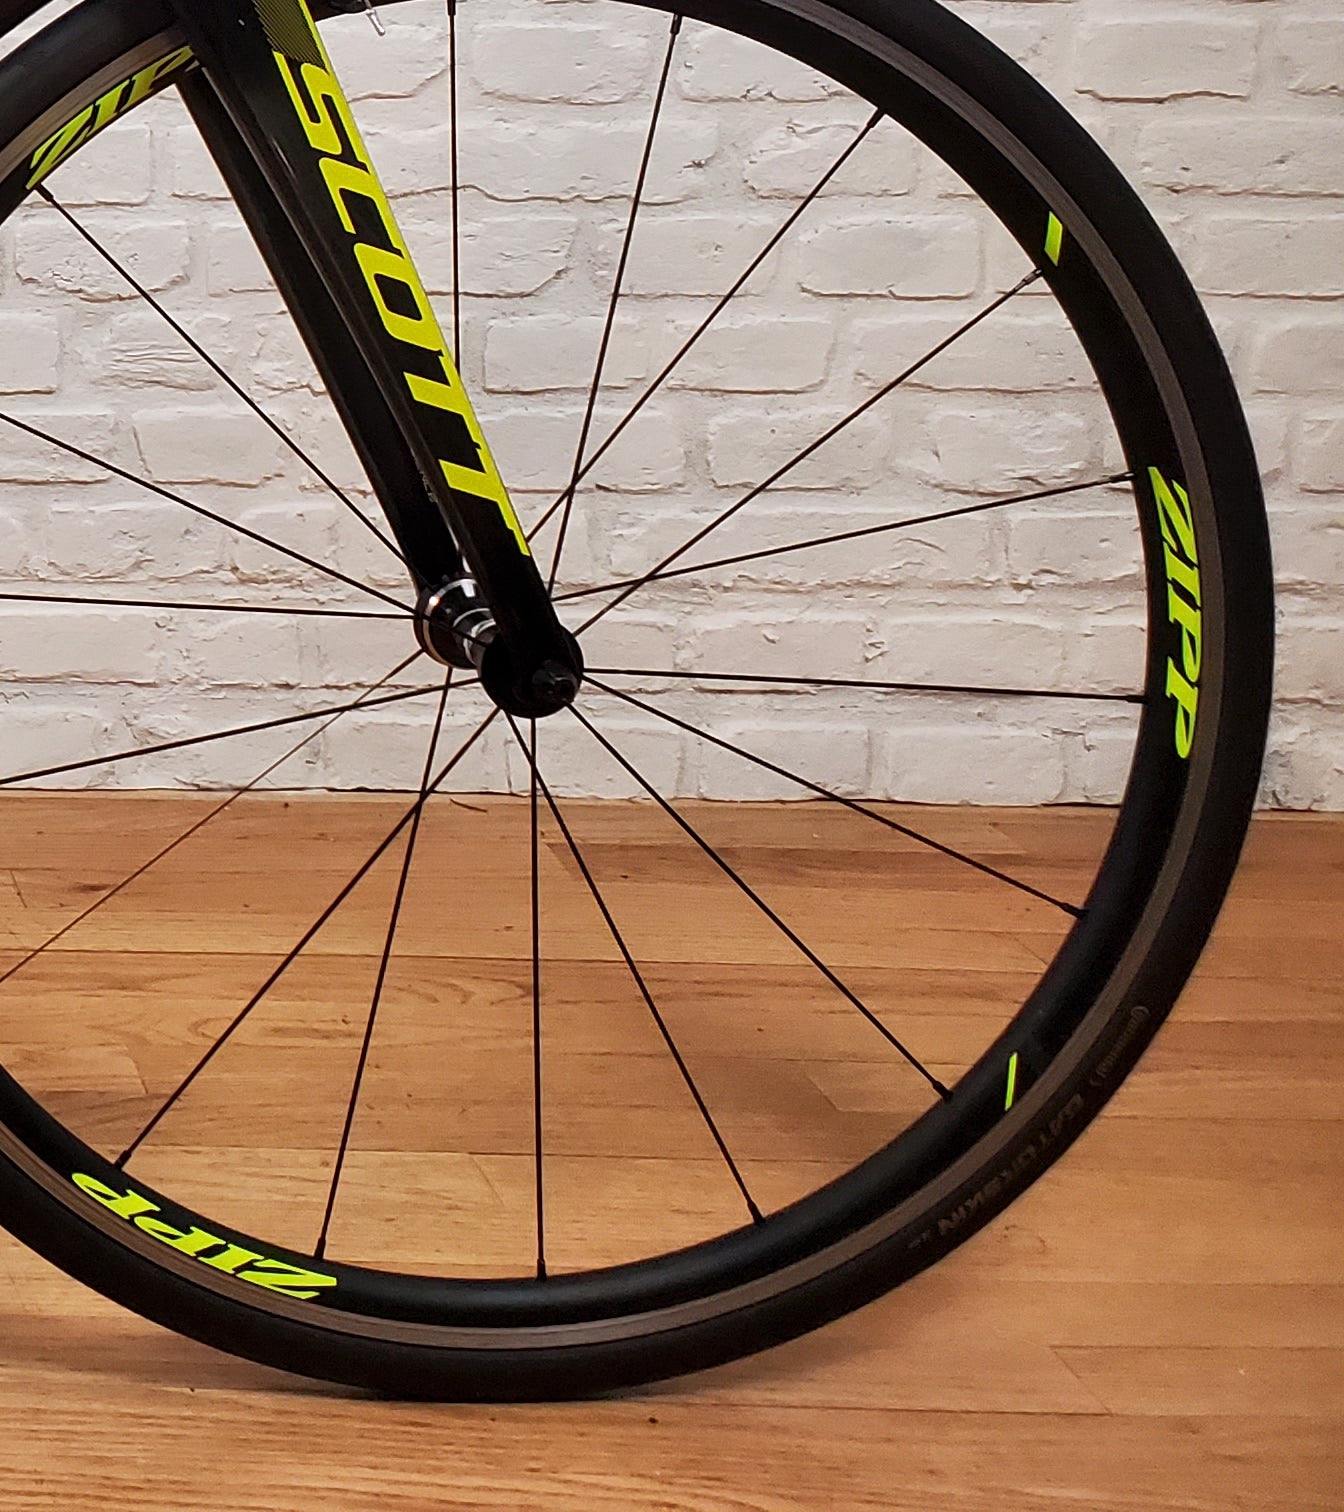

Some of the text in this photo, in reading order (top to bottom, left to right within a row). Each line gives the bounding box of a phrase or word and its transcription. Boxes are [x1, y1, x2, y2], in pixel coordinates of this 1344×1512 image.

[273, 51, 530, 556] SCOTT
[1148, 466, 1202, 760] ZIPP
[71, 1172, 338, 1300] ZIPP
